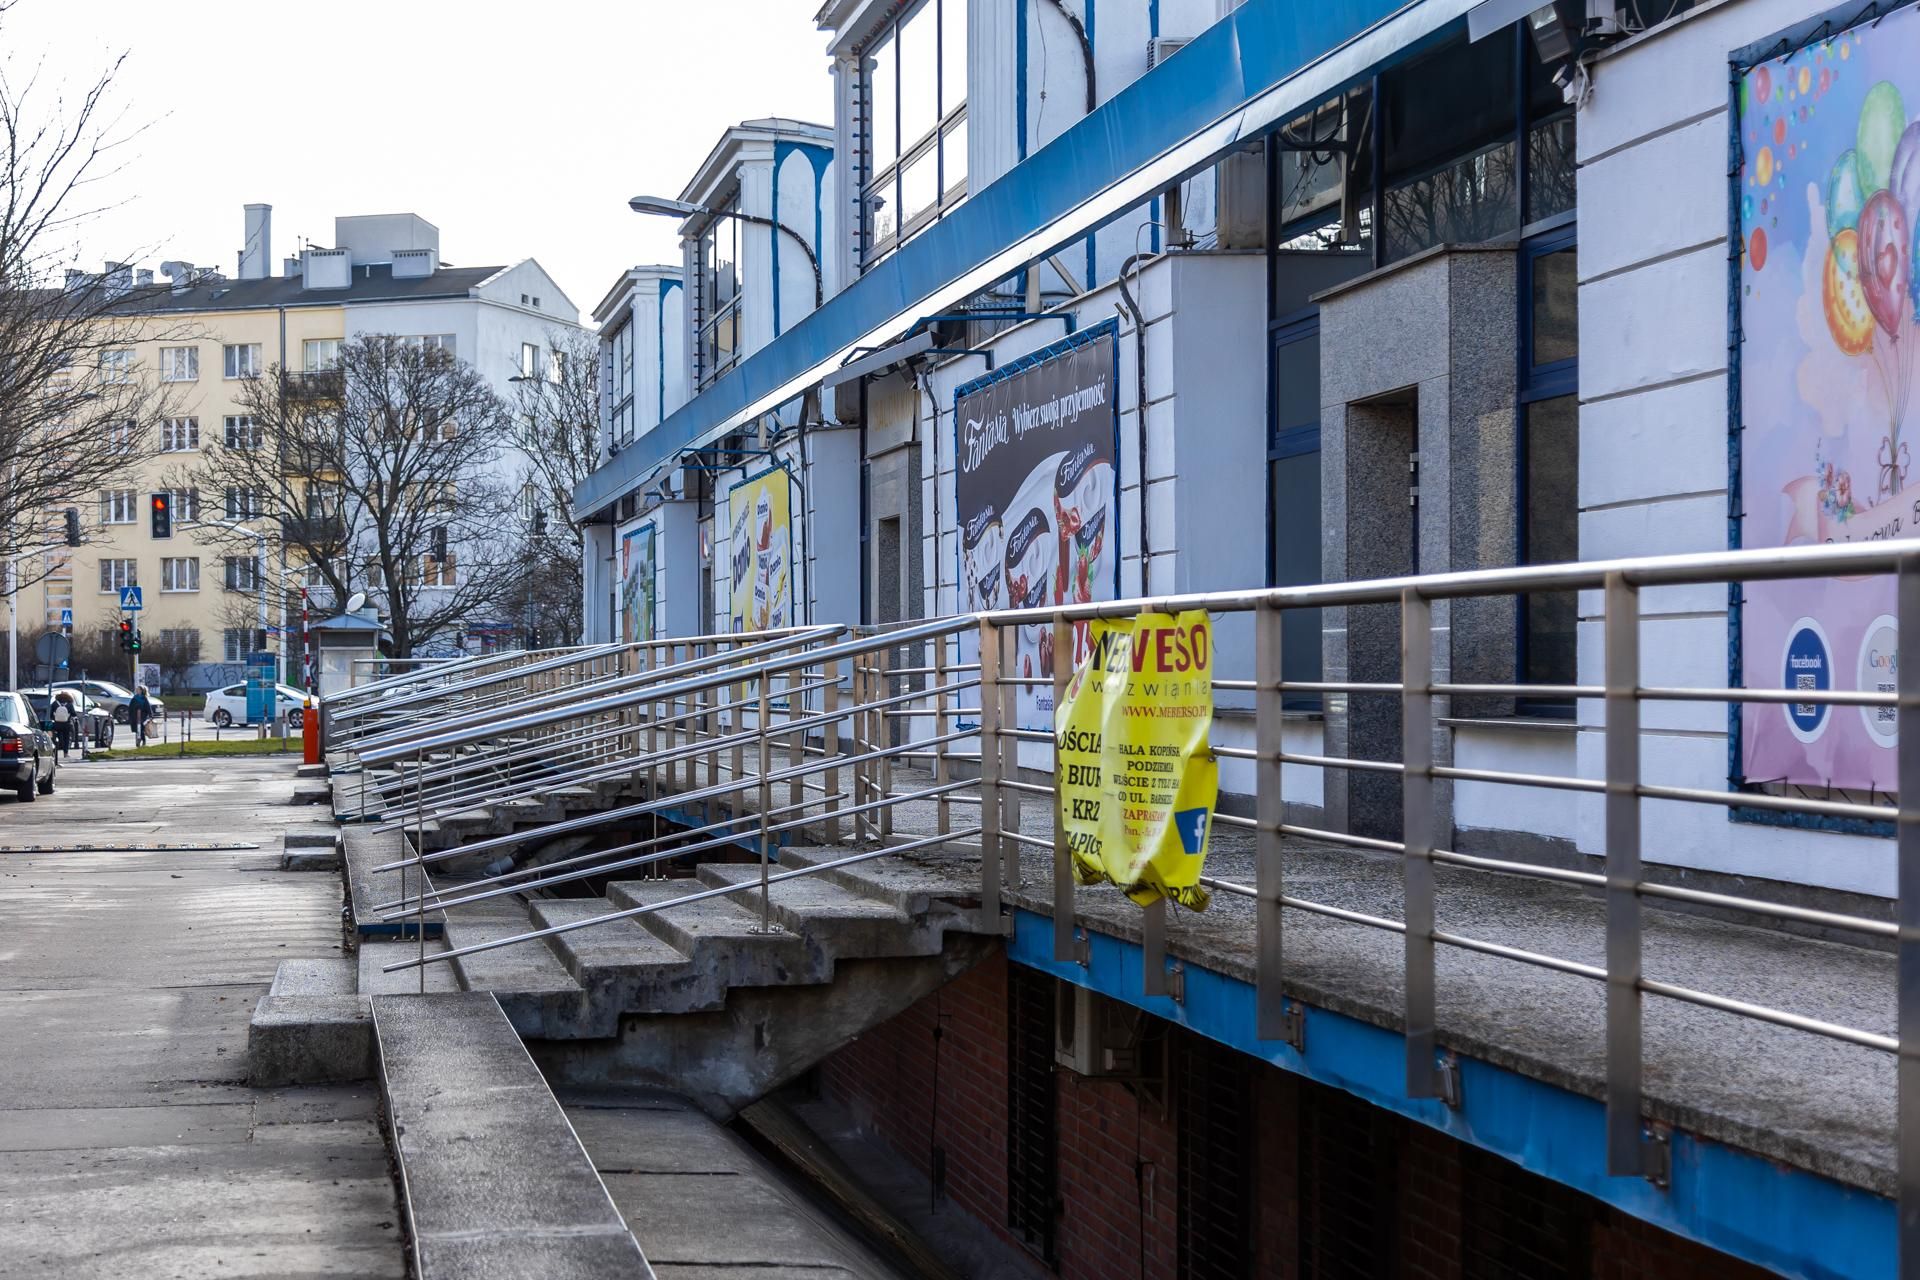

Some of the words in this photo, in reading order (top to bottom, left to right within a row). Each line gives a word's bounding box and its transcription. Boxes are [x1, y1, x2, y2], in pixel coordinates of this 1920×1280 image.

[963, 410, 1010, 473] Fantasia
[1012, 403, 1040, 440] Wybierz
[1040, 394, 1060, 430] swoją
[1060, 374, 1106, 428] przyjemność
[1060, 443, 1096, 487] Fantasia
[1010, 515, 1040, 558] Fantasia
[733, 528, 751, 594] Danio
[1790, 654, 1823, 669] facebook
[1119, 744, 1146, 756] HALA
[1129, 792, 1148, 804] UL.
